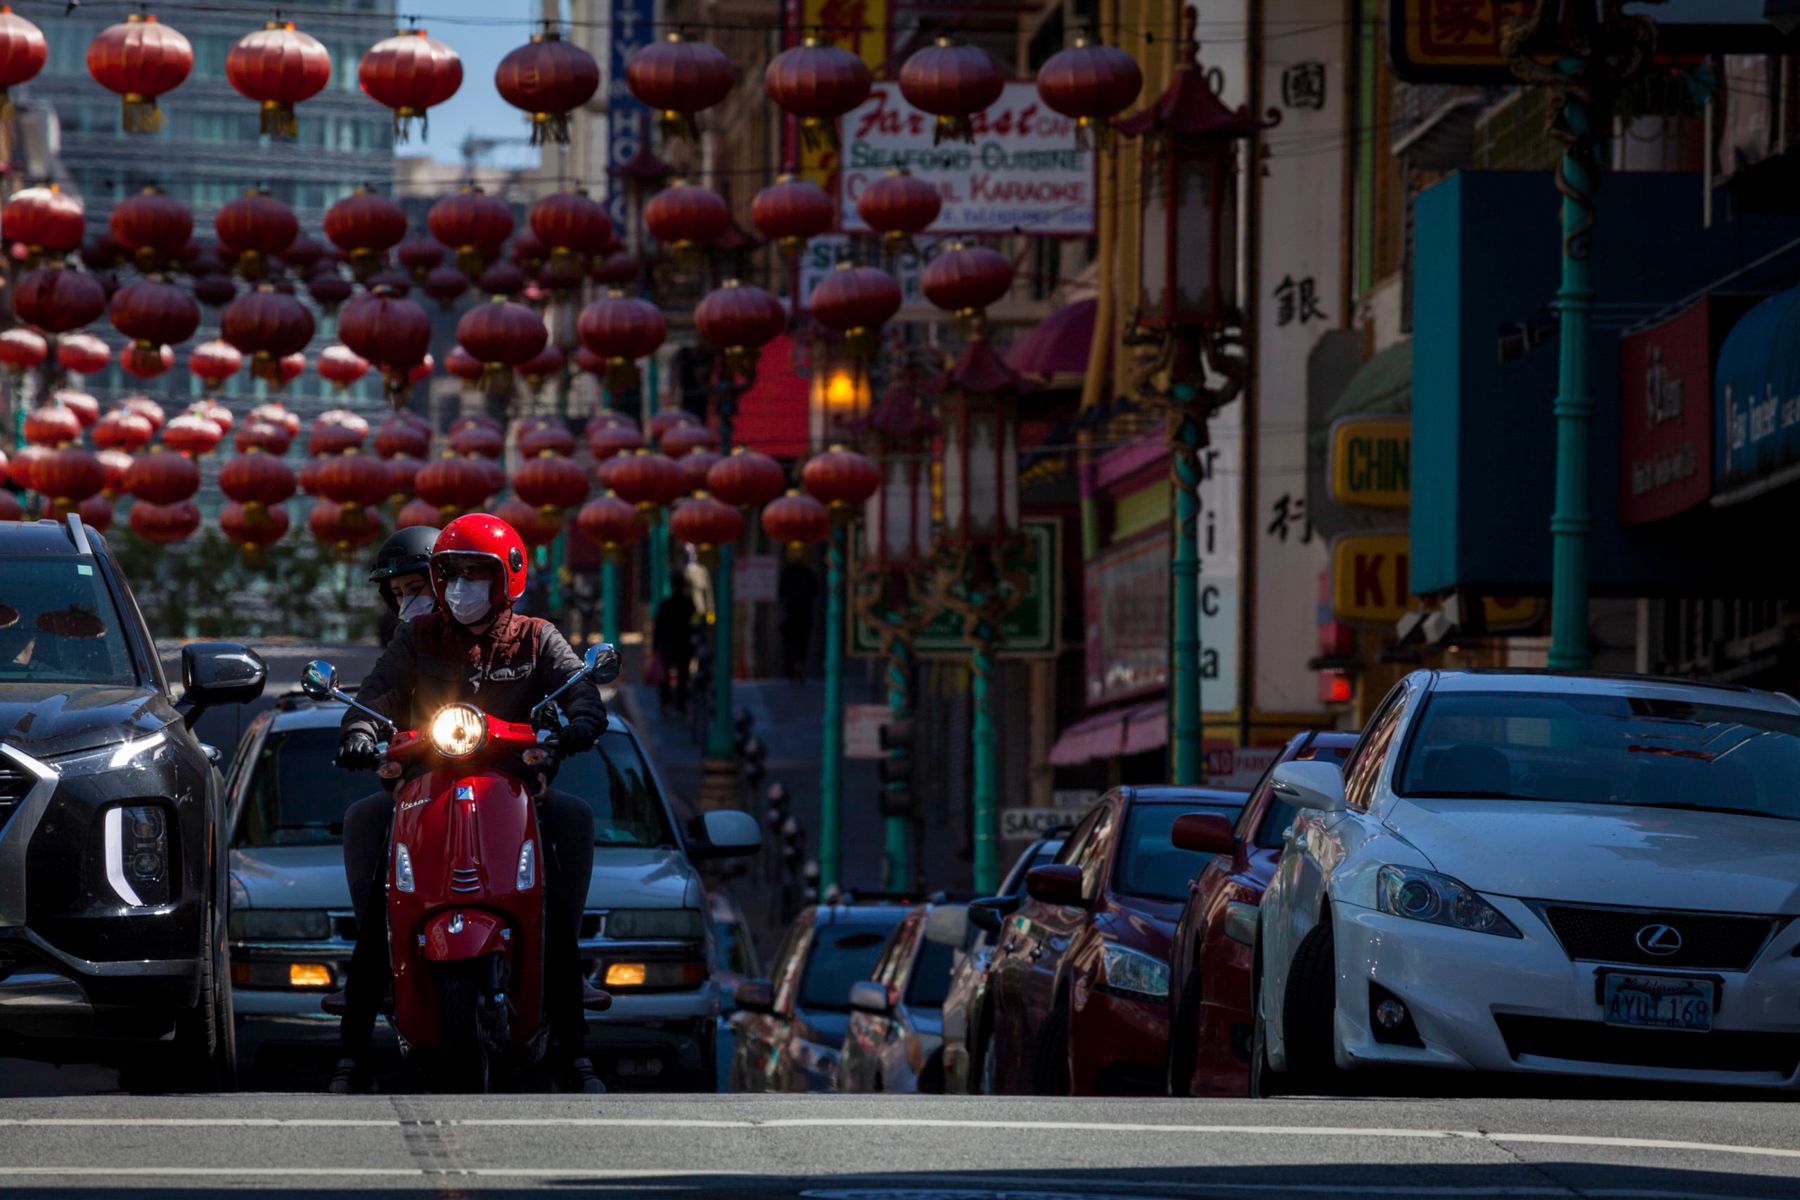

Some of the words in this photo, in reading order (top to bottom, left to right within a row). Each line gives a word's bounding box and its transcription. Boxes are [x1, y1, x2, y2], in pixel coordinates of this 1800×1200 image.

[971, 105, 1036, 136] ast
[969, 174, 1086, 202] KARAOKE
[1354, 553, 1409, 608] KI
